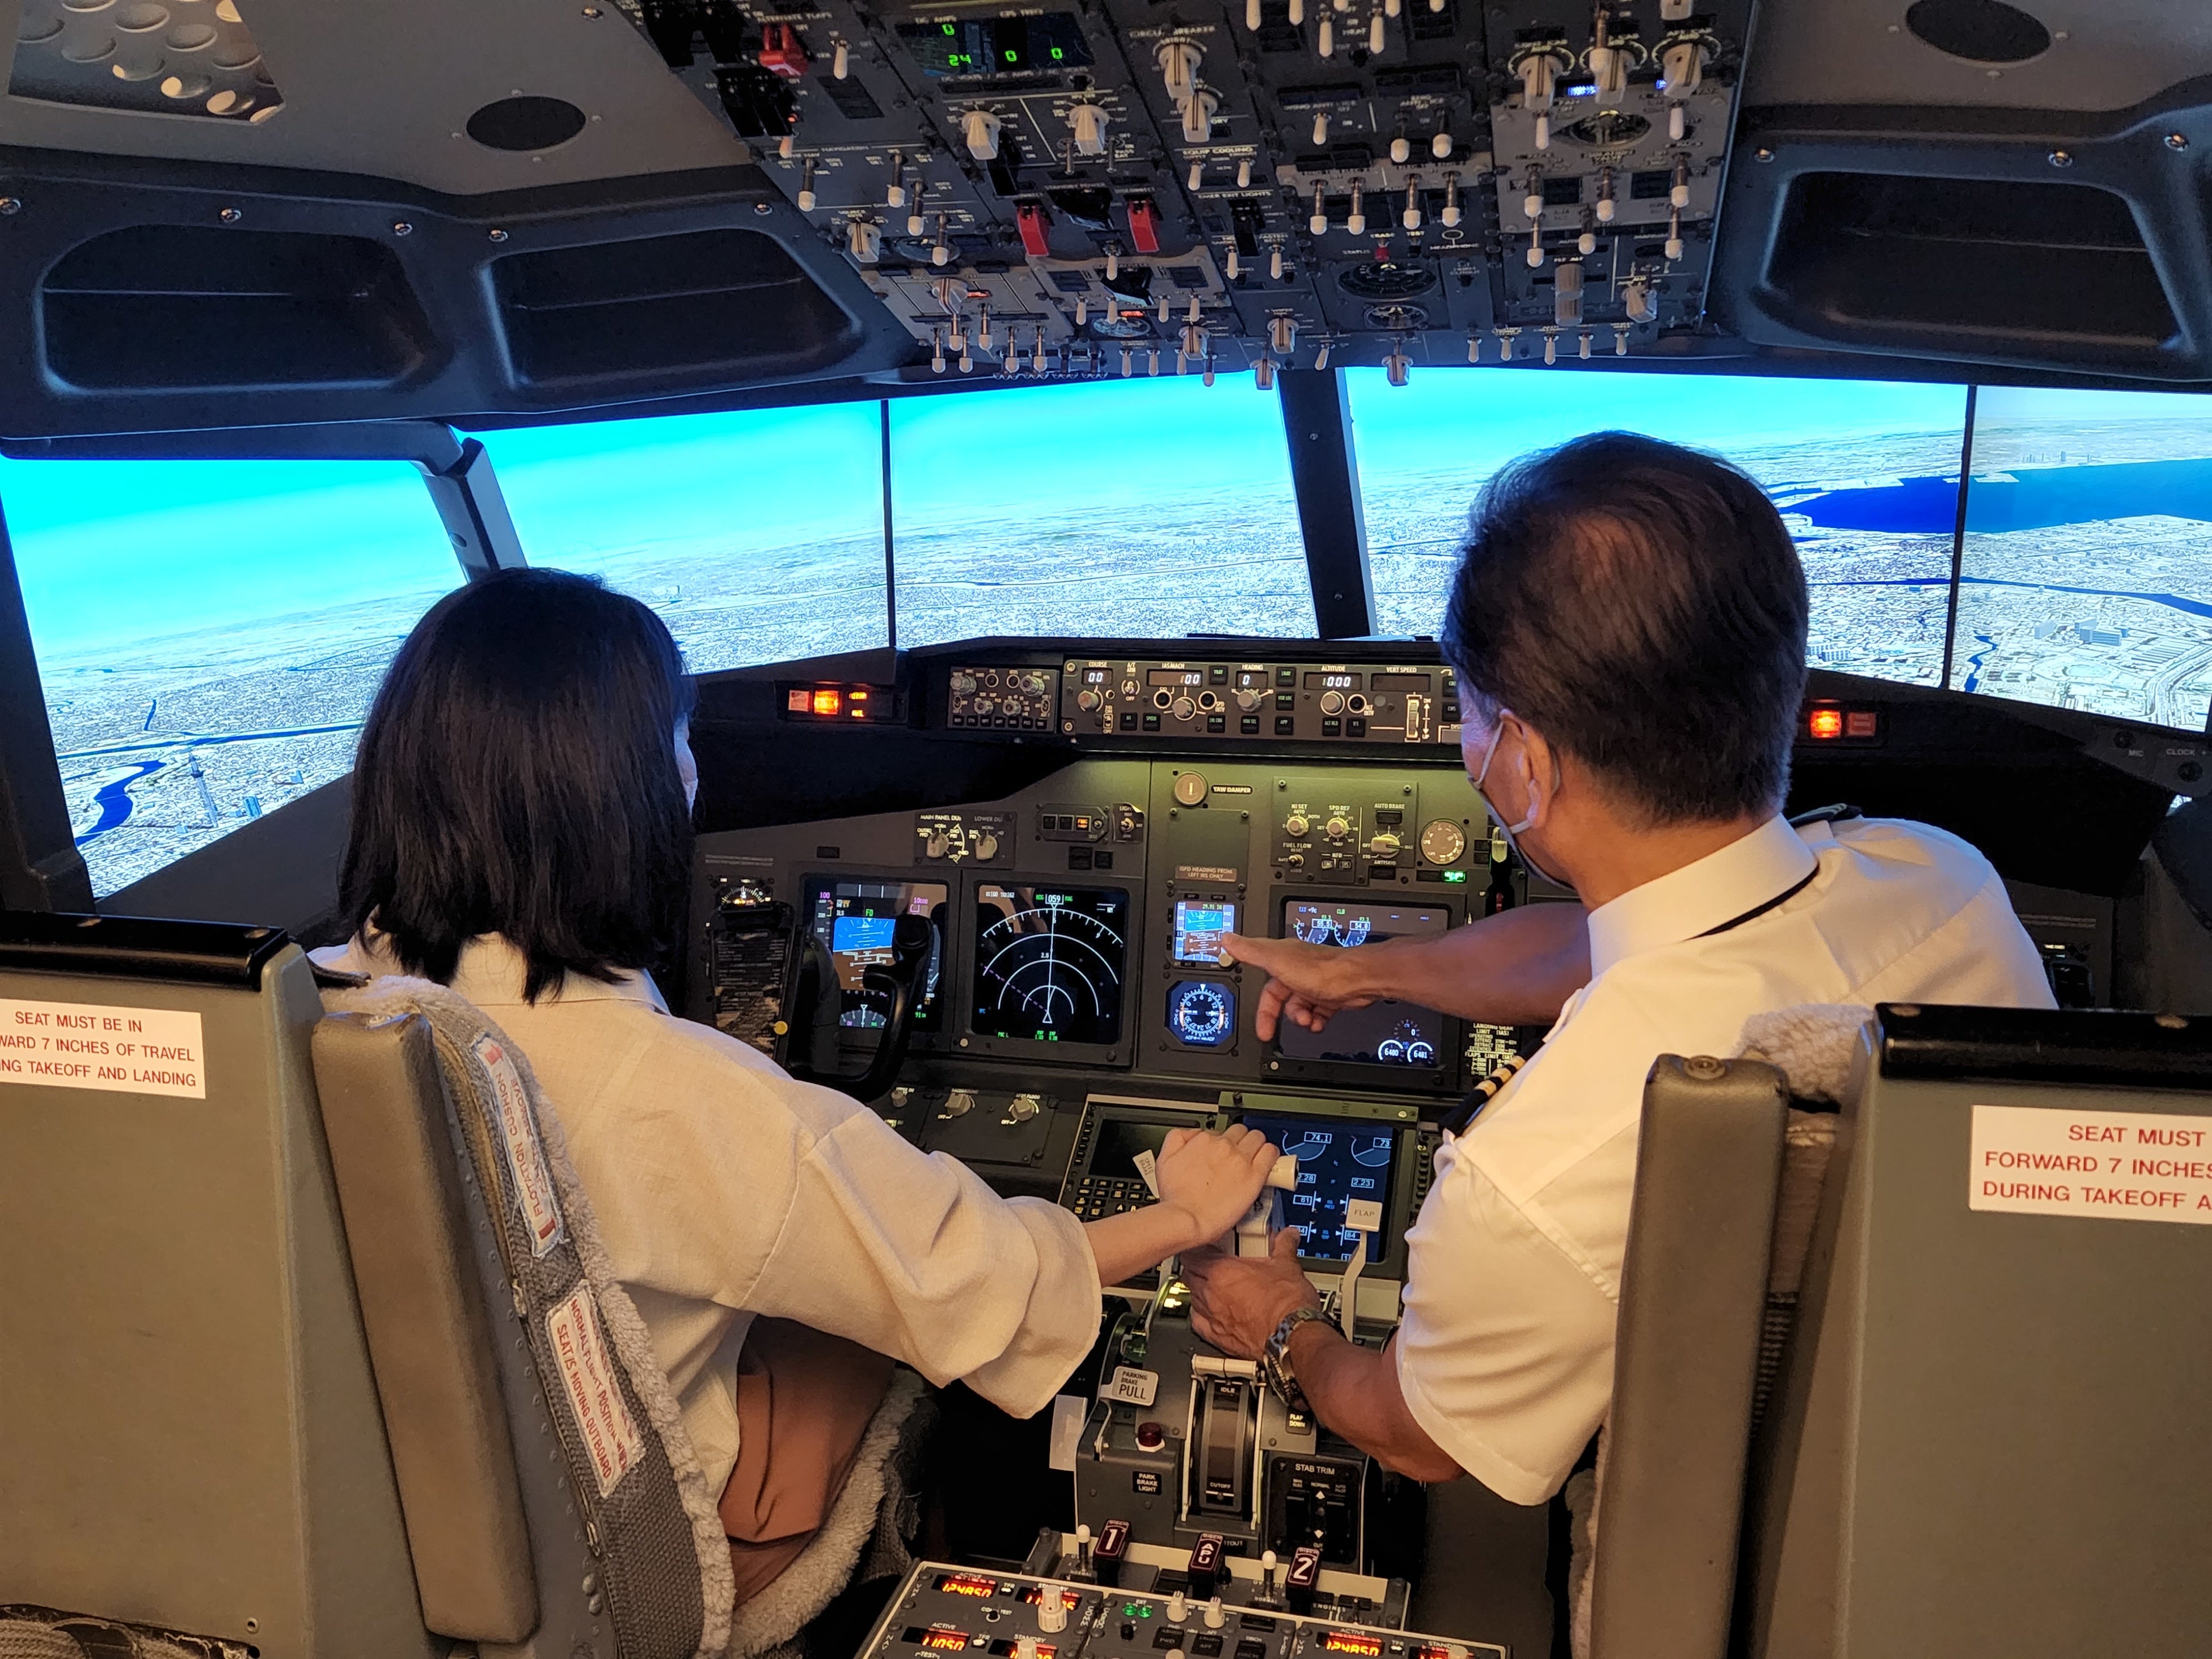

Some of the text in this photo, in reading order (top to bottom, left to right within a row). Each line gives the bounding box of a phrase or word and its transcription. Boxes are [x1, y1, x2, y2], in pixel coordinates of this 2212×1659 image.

[942, 24, 955, 35] 0
[948, 54, 972, 66] 24
[1005, 50, 1017, 62] 0
[1051, 48, 1063, 59] 0
[1088, 673, 1104, 682] 00
[1243, 674, 1251, 685] 0
[2129, 749, 2144, 757] MIC
[15, 1011, 142, 1033] SEAT MUST BE IN
[42, 1037, 50, 1050] 7
[56, 1039, 109, 1054] INCHES
[116, 1042, 136, 1056] OF
[141, 1045, 195, 1062] TRAVEL
[1413, 1050, 1428, 1058] 6481
[27, 1061, 91, 1078] TAKEOFF
[98, 1066, 126, 1080] AND
[133, 1069, 196, 1087] LANDING
[1311, 1134, 1328, 1142] 74.1
[2068, 1124, 2206, 1147] SEAT MUST
[497, 1072, 543, 1217] FLOTATION CUSHION
[1985, 1151, 2098, 1172] FORWARD
[2108, 1158, 2122, 1173] 7
[1983, 1181, 2212, 1210] DURING TAKEOFF A
[1353, 1209, 1375, 1218] FLAP
[1121, 1377, 1138, 1386] BRAKE
[1122, 1371, 1148, 1381] PARKING
[571, 1298, 627, 1472] NORMAL FLIGHT POSITION WHEN
[1119, 1384, 1146, 1400] PULL
[557, 1323, 612, 1479] SEAT IS MOVING OUTBOARD
[1295, 1463, 1335, 1475] STAB TRIM
[1105, 1529, 1118, 1550] 1
[1197, 1543, 1214, 1564] APU
[1293, 1556, 1313, 1580] 2
[1079, 1605, 1095, 1627] COMM
[882, 1633, 894, 1651] NAV
[1014, 1633, 1046, 1644] STANDBY
